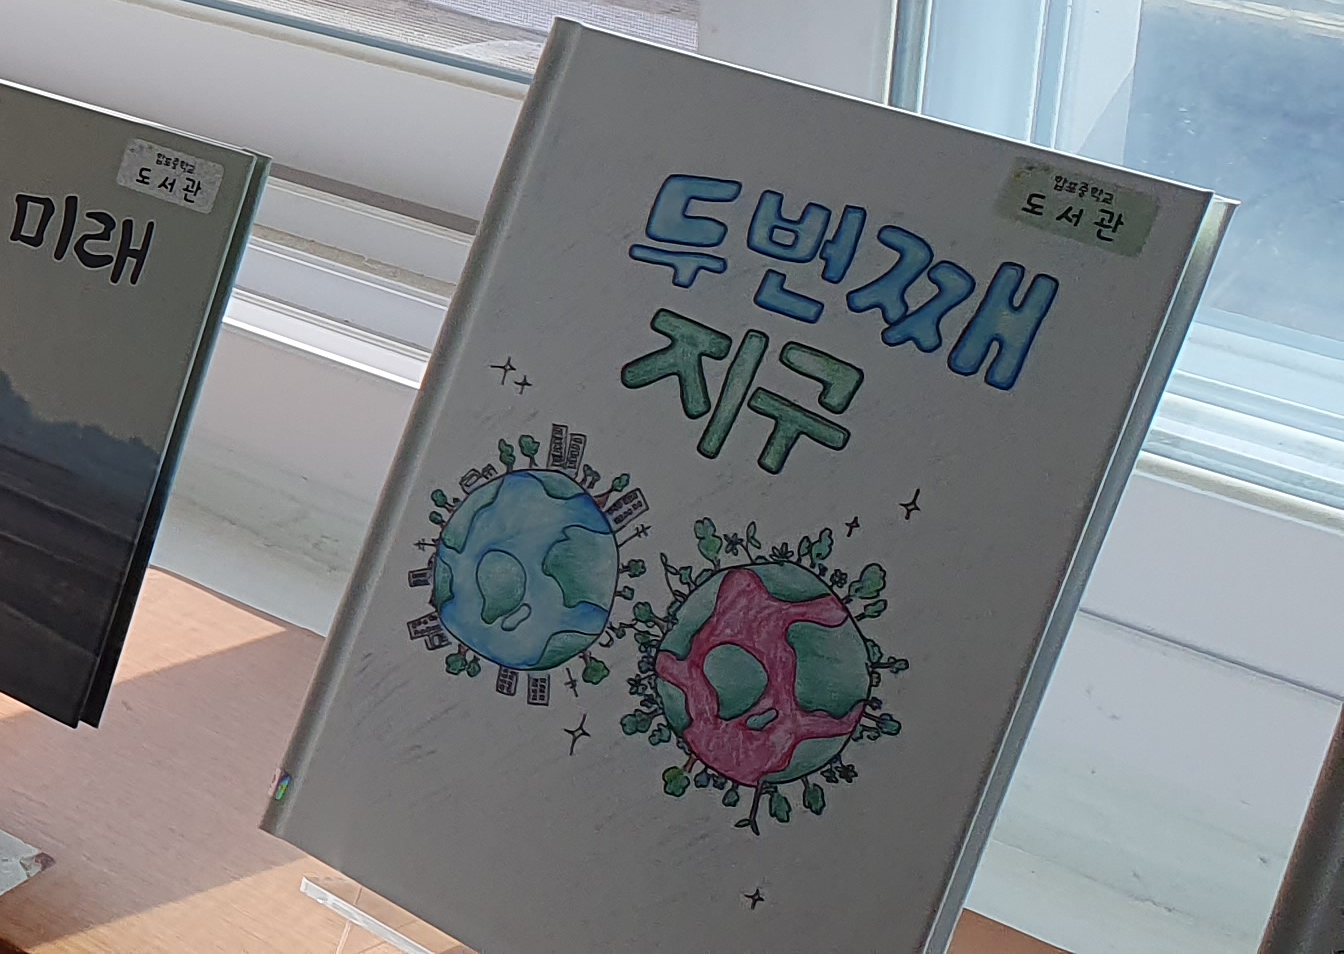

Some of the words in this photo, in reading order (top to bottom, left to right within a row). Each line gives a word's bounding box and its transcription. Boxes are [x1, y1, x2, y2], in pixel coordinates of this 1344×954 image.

[135, 167, 202, 204] 도서관
[1021, 192, 1125, 242] 도서관
[11, 191, 156, 287] 미래
[628, 173, 1059, 391] 두번째
[621, 307, 864, 475] 지구
